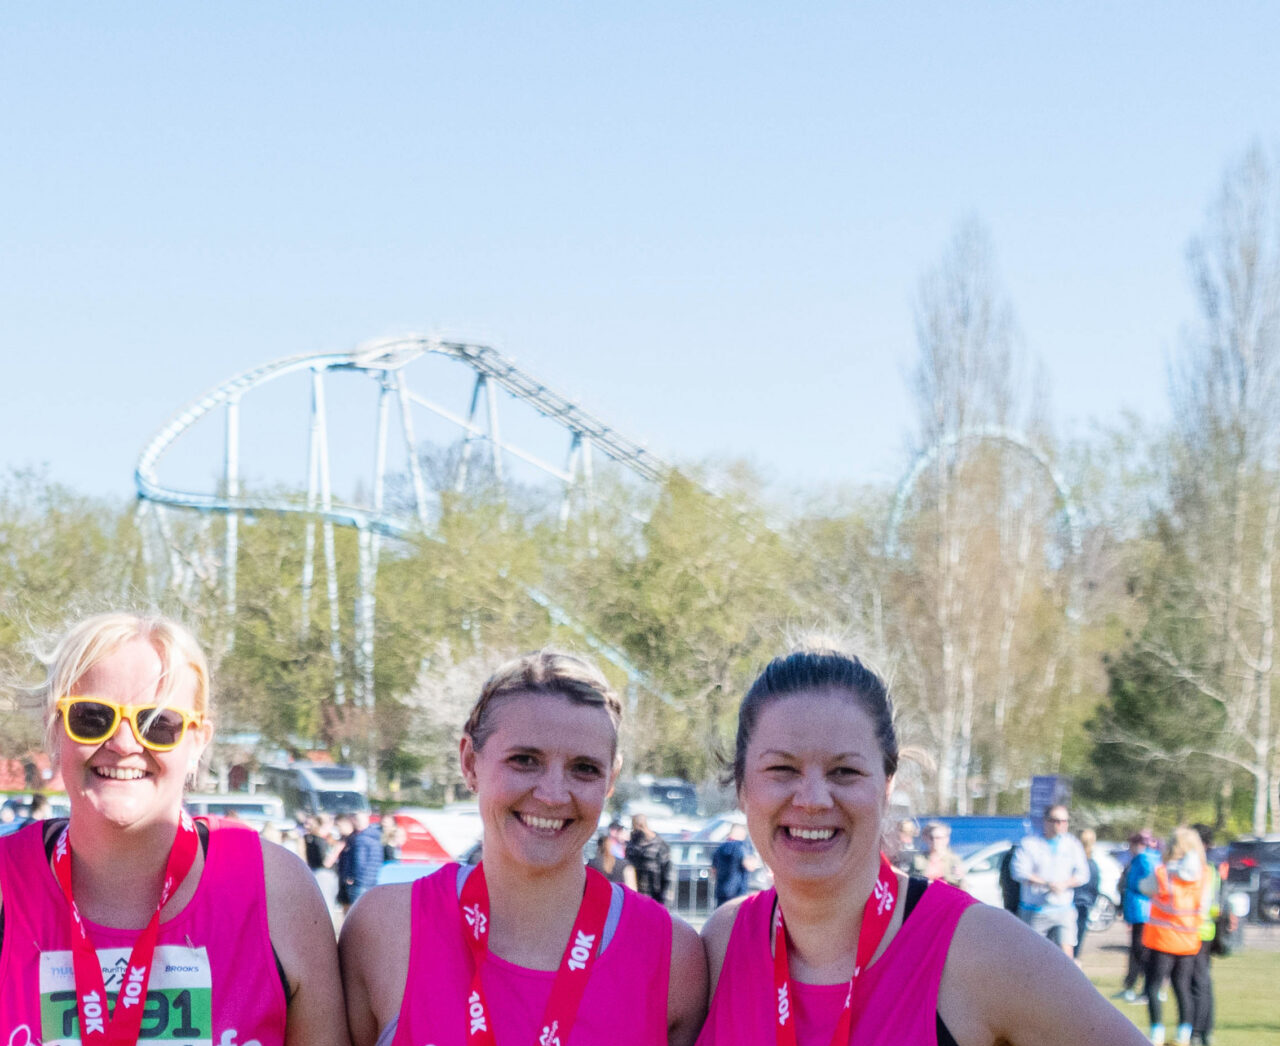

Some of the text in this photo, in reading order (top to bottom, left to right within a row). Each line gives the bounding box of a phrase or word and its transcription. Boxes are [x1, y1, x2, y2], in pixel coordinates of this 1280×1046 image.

[165, 964, 199, 974] BROOKS
[567, 930, 596, 971] 10K
[123, 965, 147, 1009] 10K
[778, 981, 790, 1026] 10K
[50, 988, 201, 1037] 791
[82, 990, 105, 1035] 10K
[468, 990, 487, 1036] 10K
